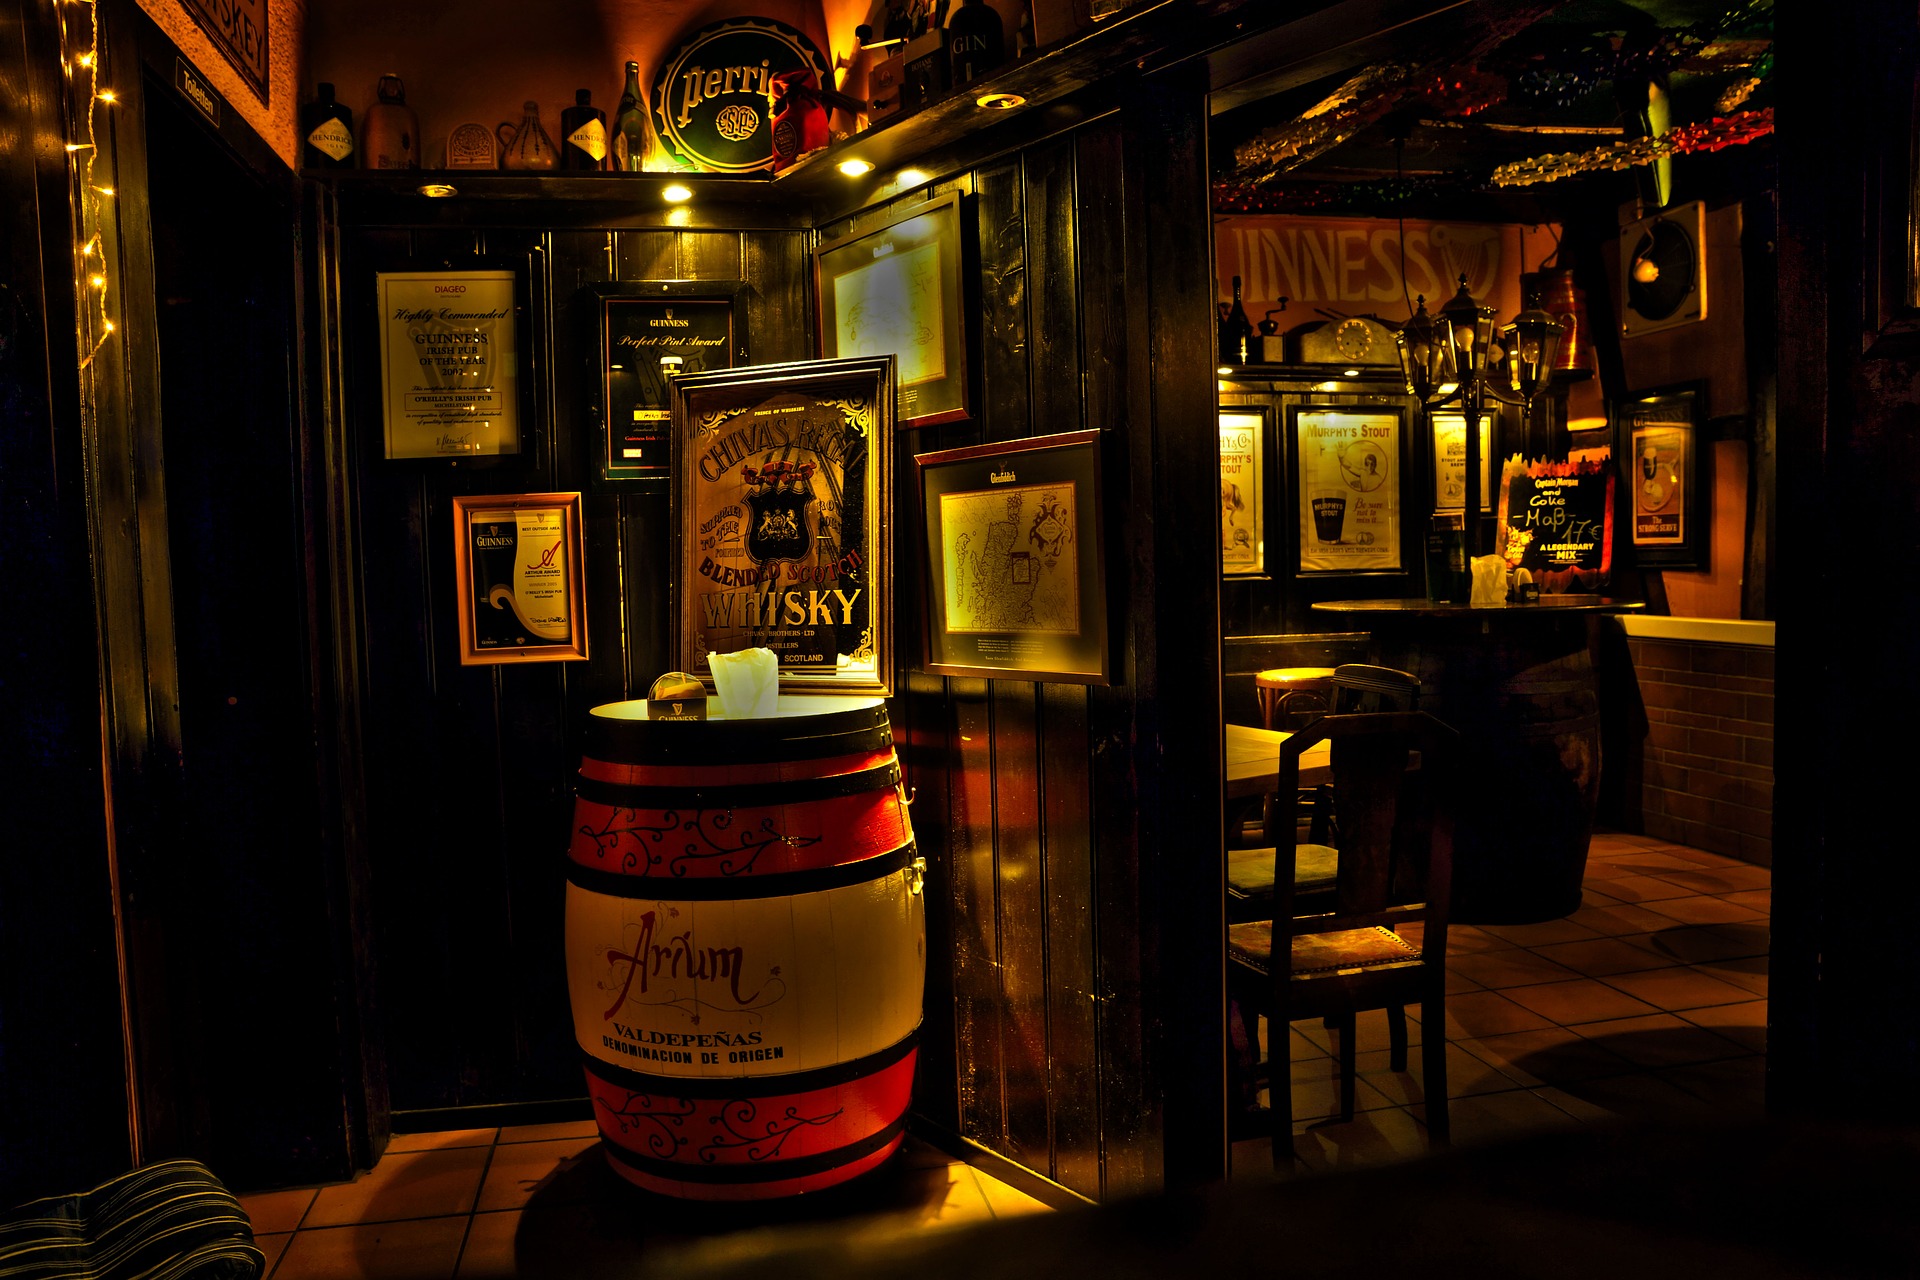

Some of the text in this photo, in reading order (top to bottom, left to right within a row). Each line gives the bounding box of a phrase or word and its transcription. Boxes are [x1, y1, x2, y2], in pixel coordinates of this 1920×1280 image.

[952, 35, 988, 54] GIN
[183, 70, 214, 116] Toiletten
[434, 285, 467, 294] DIAGEO
[394, 307, 510, 324] Highly Commended
[650, 319, 689, 328] GUINNESS
[415, 333, 488, 345] GUINNESS
[617, 334, 726, 349] Perfect Pint Award
[427, 346, 478, 355] IRISH PUB
[420, 357, 486, 366] OF THE YEAR
[414, 395, 454, 403] O'REILLY'S
[1307, 424, 1391, 438] MURPHY'S STOUT
[700, 417, 791, 483] CHIVAS
[1542, 487, 1562, 496] and
[1353, 497, 1366, 512] Be
[1529, 495, 1566, 507] Coke
[476, 536, 514, 547] GUINNESS
[701, 521, 740, 551] TO THE
[1547, 543, 1594, 551] LEGENDARY
[1556, 551, 1577, 560] MIX
[699, 549, 864, 587] BLENDED SCOTCH
[700, 589, 862, 629] WHISKY
[784, 654, 824, 662] SCOTLAND
[604, 911, 760, 1021] Arium
[613, 1022, 763, 1048] VALDEPEÑAS
[602, 1034, 785, 1065] DENOMINACION DE ORIGEN
